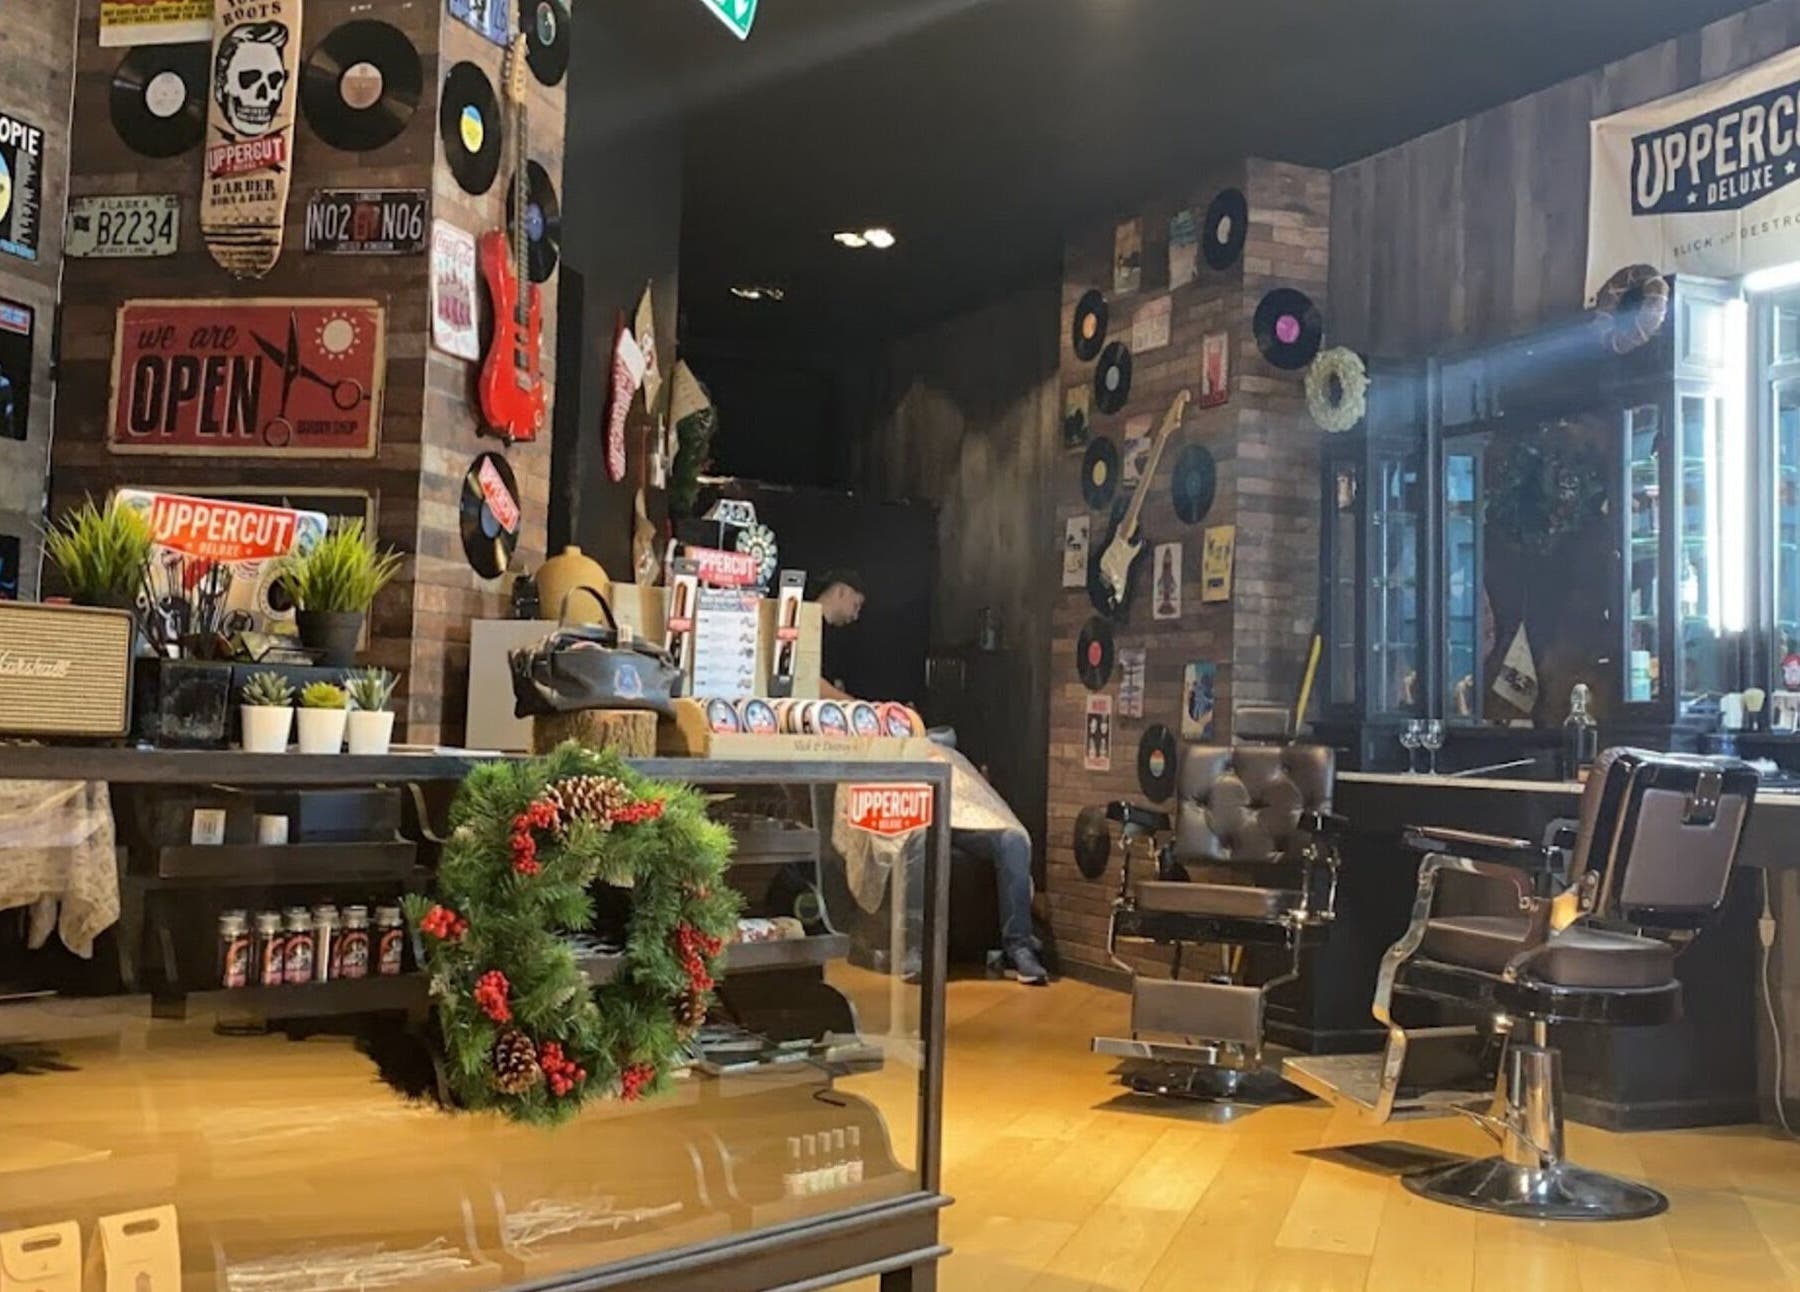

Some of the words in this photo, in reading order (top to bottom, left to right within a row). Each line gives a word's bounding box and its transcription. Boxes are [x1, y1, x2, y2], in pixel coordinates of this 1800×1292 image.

[223, 1, 281, 26] ROOTS
[208, 138, 283, 172] UPPERCUT
[1637, 88, 1800, 210] UPPERC
[212, 180, 276, 196] BARBER
[1707, 164, 1774, 205] DELUXE
[97, 209, 174, 246] B2234
[137, 325, 176, 350] we
[189, 324, 239, 350] are
[127, 354, 263, 437] OPEN
[154, 500, 292, 554] UPPERCUT
[853, 791, 929, 823] UPPERCUT
